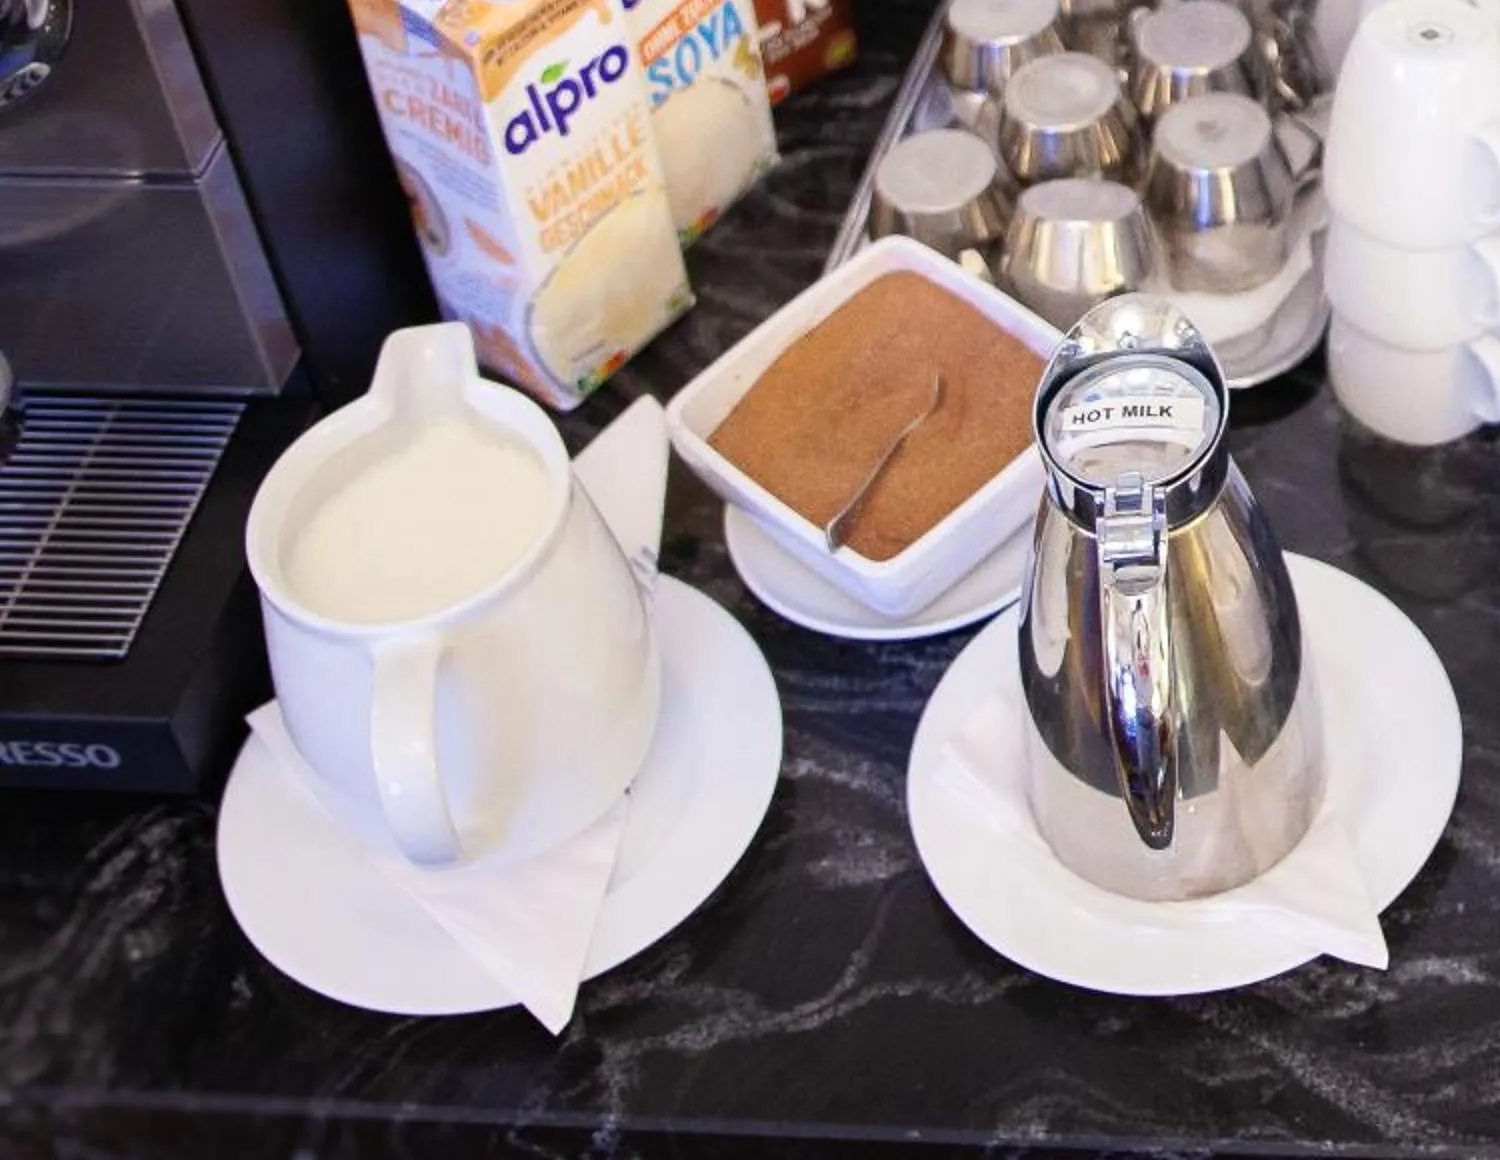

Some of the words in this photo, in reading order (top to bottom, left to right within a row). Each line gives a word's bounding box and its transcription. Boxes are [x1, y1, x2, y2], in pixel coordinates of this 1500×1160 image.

[505, 45, 629, 154] alpro
[647, 0, 744, 106] SOYA
[528, 106, 645, 222] VANILLE
[1073, 407, 1114, 425] HOT
[1121, 405, 1172, 419] MILK
